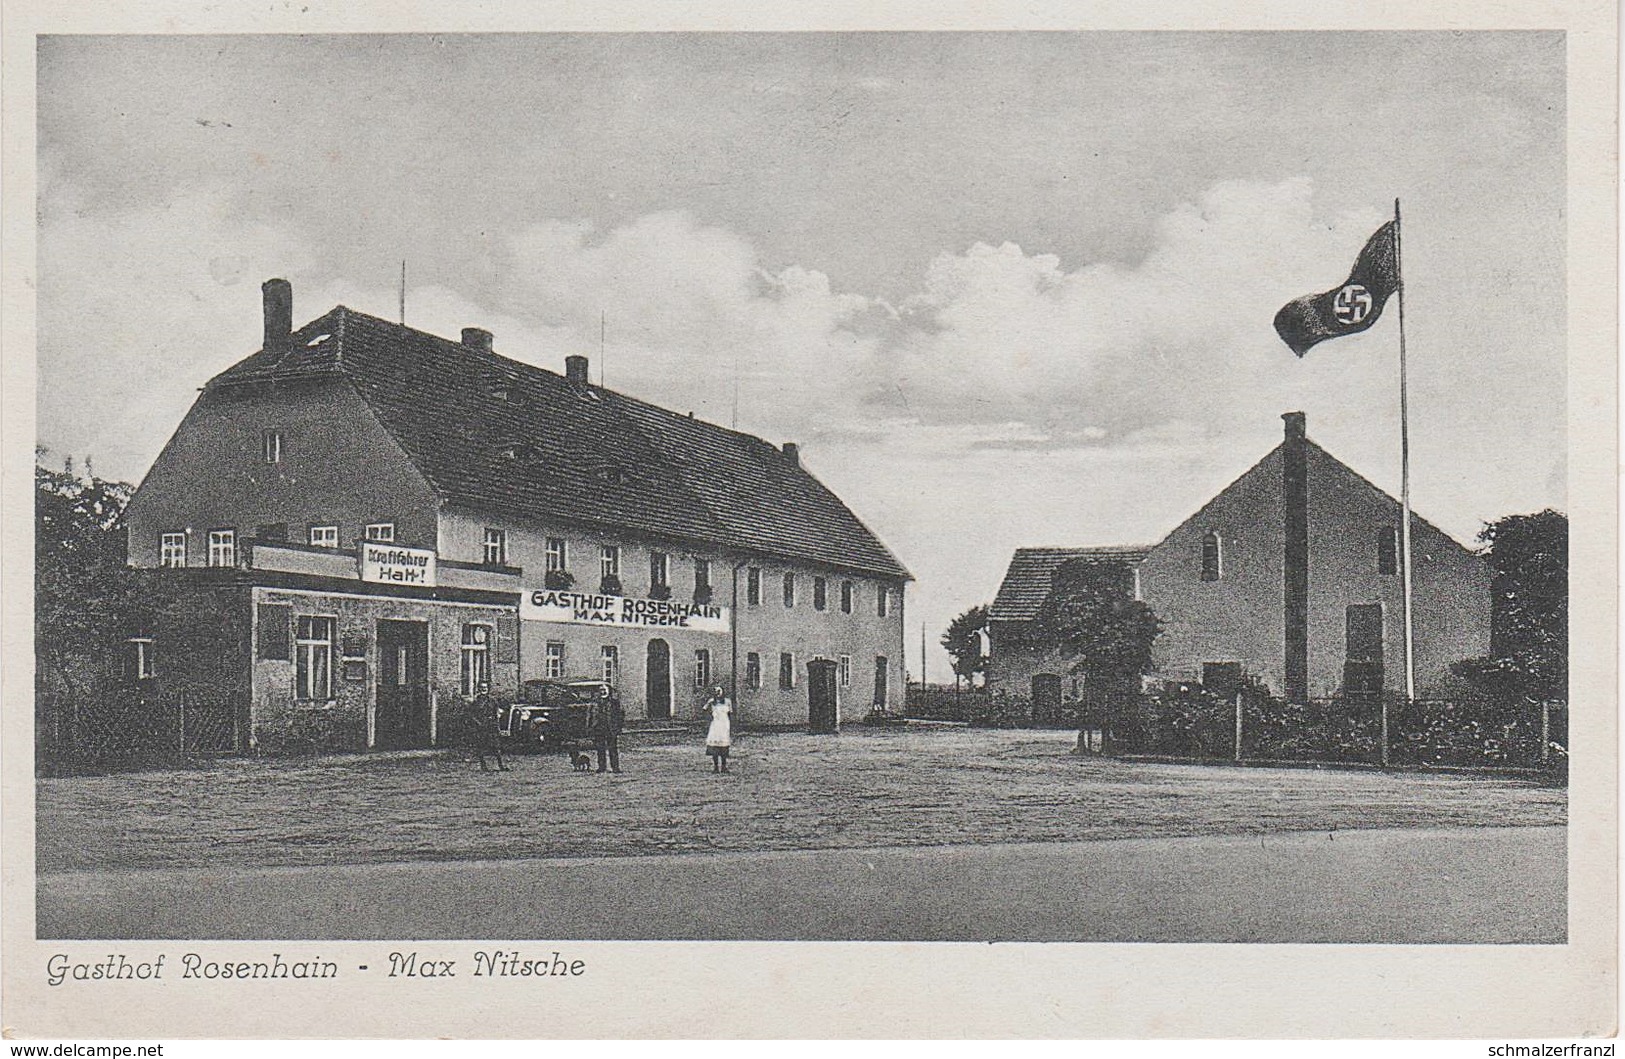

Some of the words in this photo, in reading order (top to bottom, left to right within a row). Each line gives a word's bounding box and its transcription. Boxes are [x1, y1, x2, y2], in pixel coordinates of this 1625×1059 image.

[368, 548, 429, 567] Kraftfahrer
[379, 566, 426, 584] Halt!
[531, 590, 615, 610] GASTHOF
[623, 599, 721, 619] ROSENHAIN
[573, 609, 615, 623] MAX
[621, 613, 691, 628] NITSCHE
